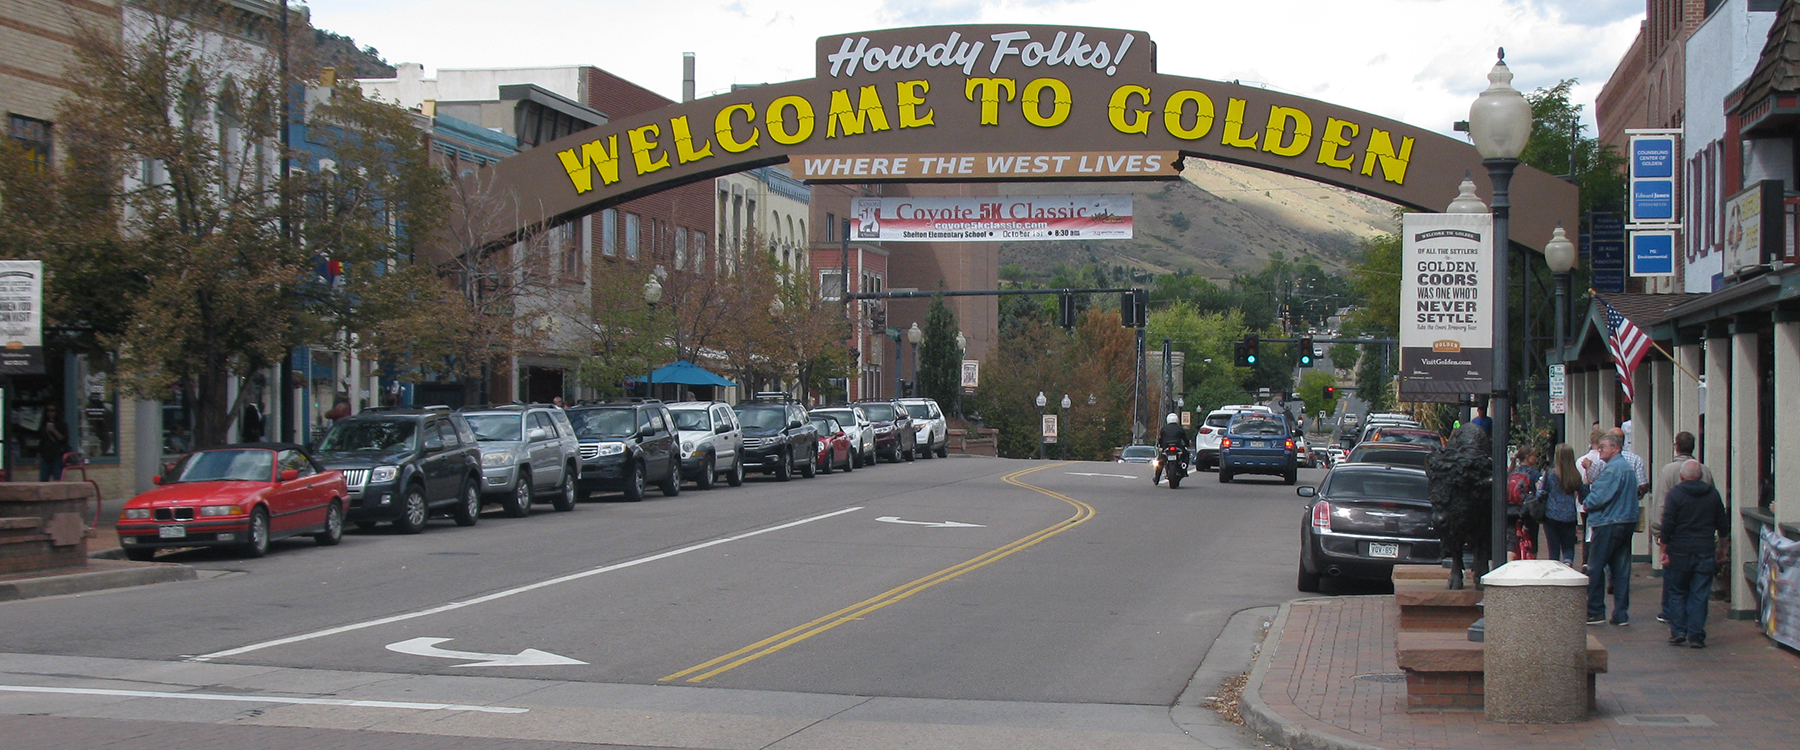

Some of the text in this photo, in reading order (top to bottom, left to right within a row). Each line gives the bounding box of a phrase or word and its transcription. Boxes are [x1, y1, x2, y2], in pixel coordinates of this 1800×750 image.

[828, 30, 1135, 77] Howdy Folks!
[556, 77, 1416, 195] WELCOME TO GOLDEN
[804, 154, 1162, 176] WHERE THE WEST LIVES
[896, 202, 1087, 226] Coyote 5K Classic
[935, 221, 1047, 230] coyote5kclassic.com
[928, 231, 964, 239] Elementary
[1421, 231, 1445, 239] WELCOME
[1455, 231, 1474, 239] GOLDEN
[1417, 261, 1479, 273] GOLDEN,
[1417, 273, 1478, 286] COORS
[1417, 287, 1477, 299] WAS ONE WHO'D
[18, 302, 31, 311] YOU
[1417, 301, 1477, 312] NEVER
[12, 312, 31, 321] VISIT
[1417, 314, 1477, 323] SETTLE.
